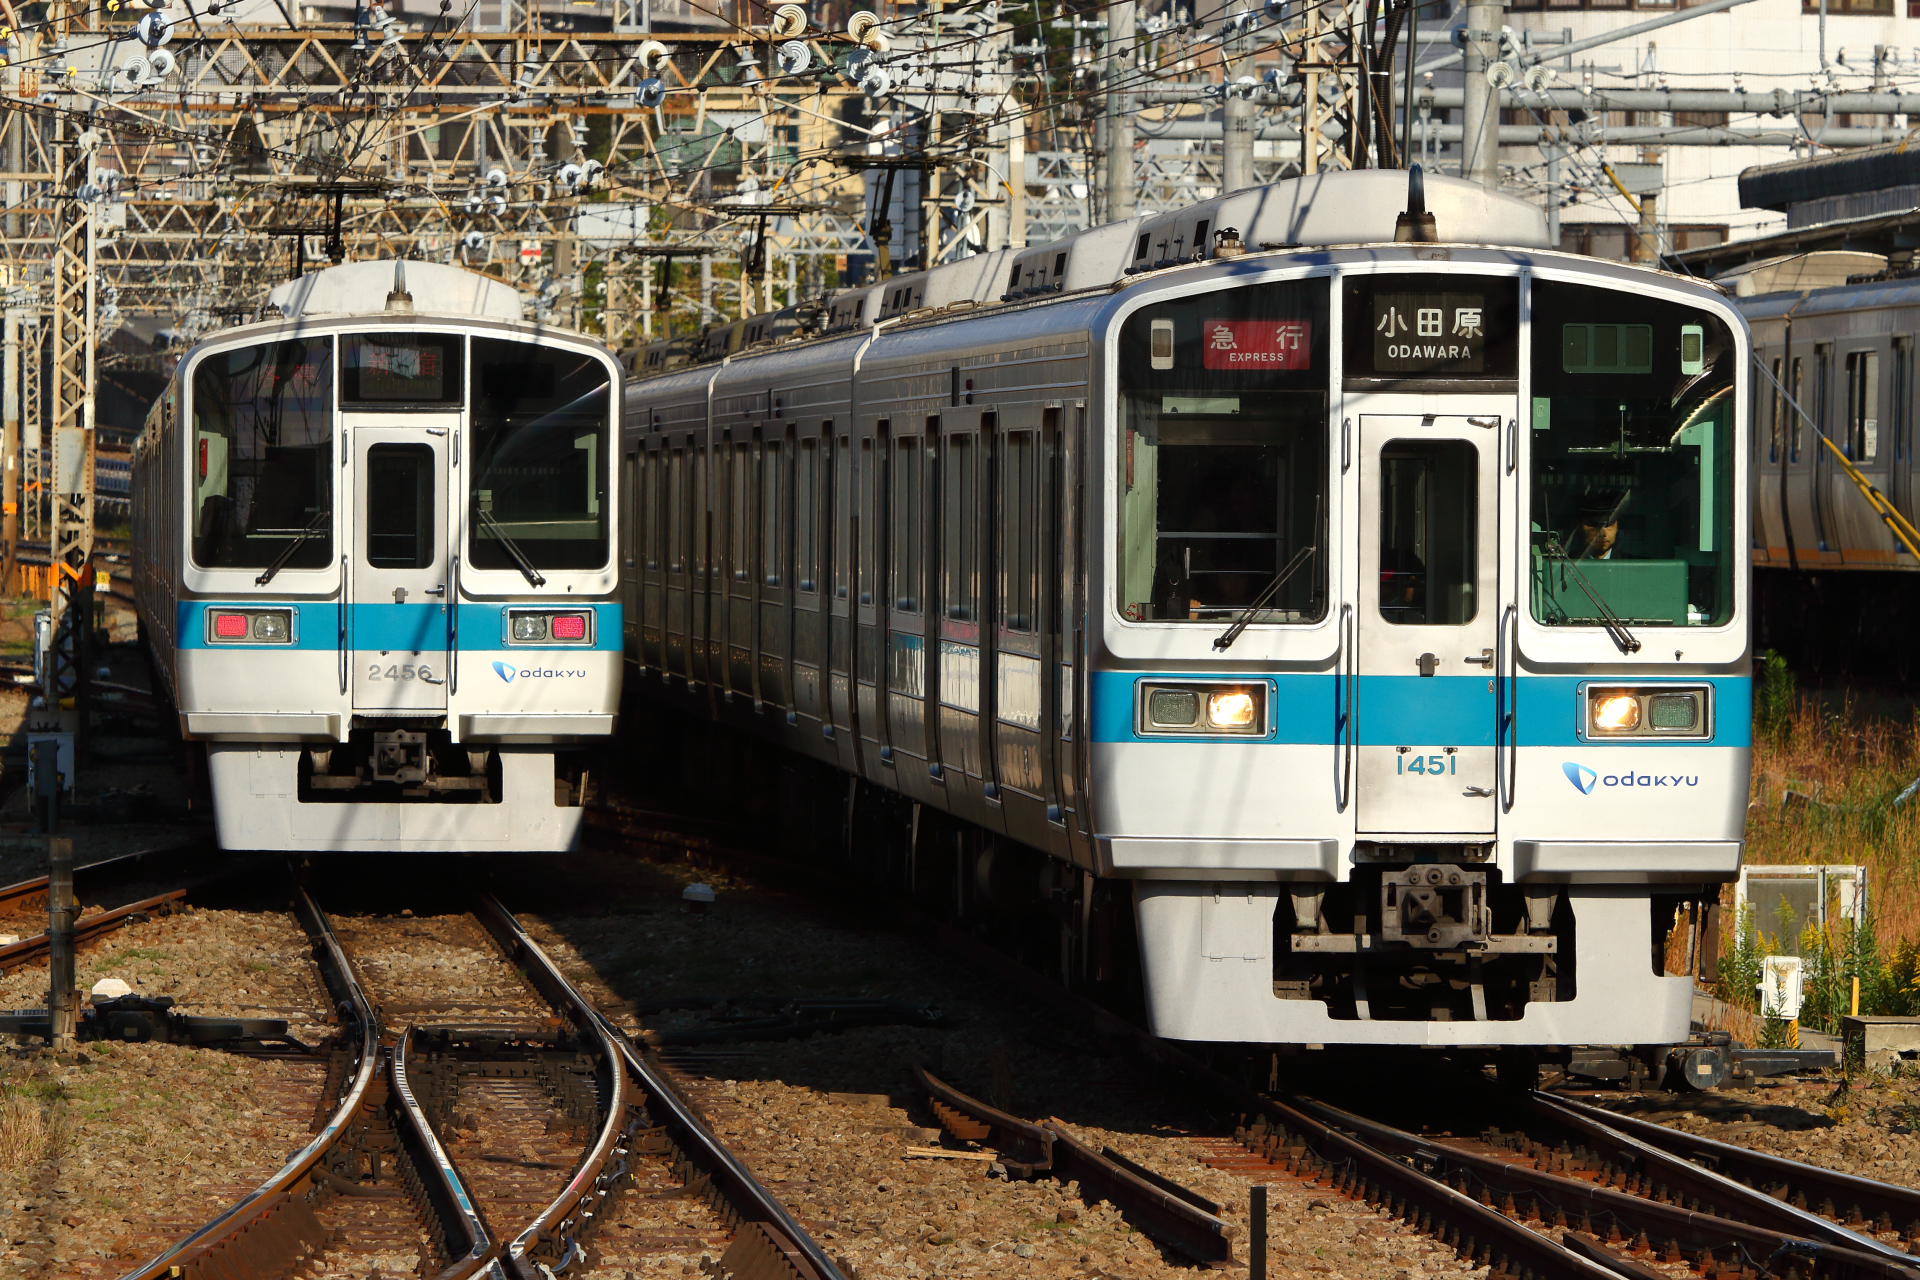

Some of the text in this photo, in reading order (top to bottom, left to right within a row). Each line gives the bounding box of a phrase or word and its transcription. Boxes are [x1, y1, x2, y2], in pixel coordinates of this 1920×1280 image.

[1377, 306, 1484, 338] 小田原
[1210, 325, 1304, 350] 急行
[1229, 352, 1285, 362] EXPRESS
[1388, 345, 1472, 359] ODAWARA
[368, 664, 433, 682] 2456
[520, 667, 586, 678] odakyu
[1397, 755, 1456, 775] 1451
[1603, 771, 1698, 787] odakyu
